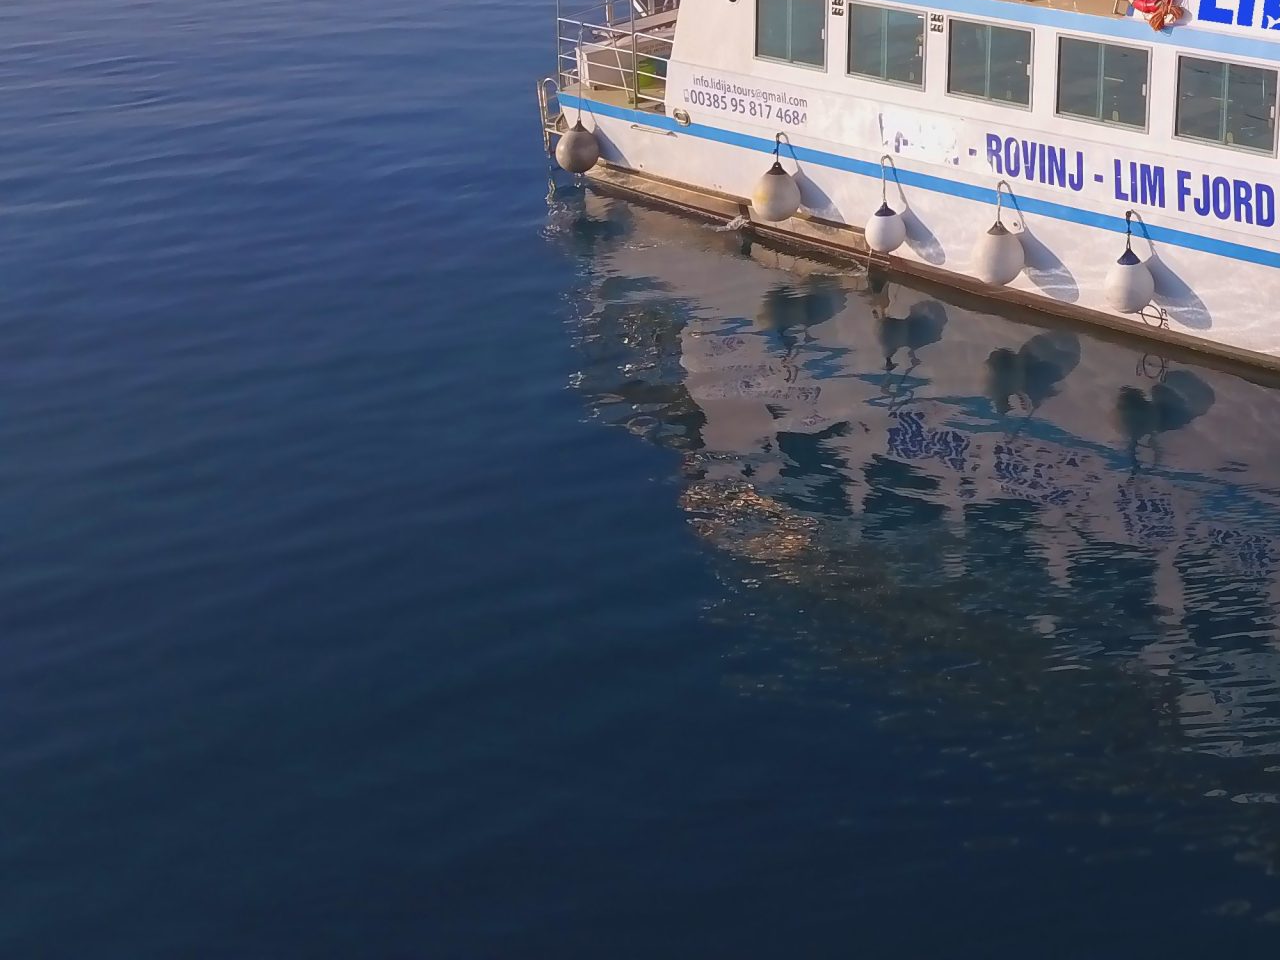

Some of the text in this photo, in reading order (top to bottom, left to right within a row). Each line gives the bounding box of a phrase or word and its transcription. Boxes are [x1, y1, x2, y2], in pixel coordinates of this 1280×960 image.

[690, 89, 728, 110] 00385
[730, 97, 746, 114] 95
[749, 101, 772, 119] 817
[692, 74, 808, 108] info.lidija.tours@gmail.com
[986, 133, 1084, 191] ROVINJ
[1114, 159, 1165, 209] LIM
[1176, 169, 1276, 228] FJORD
